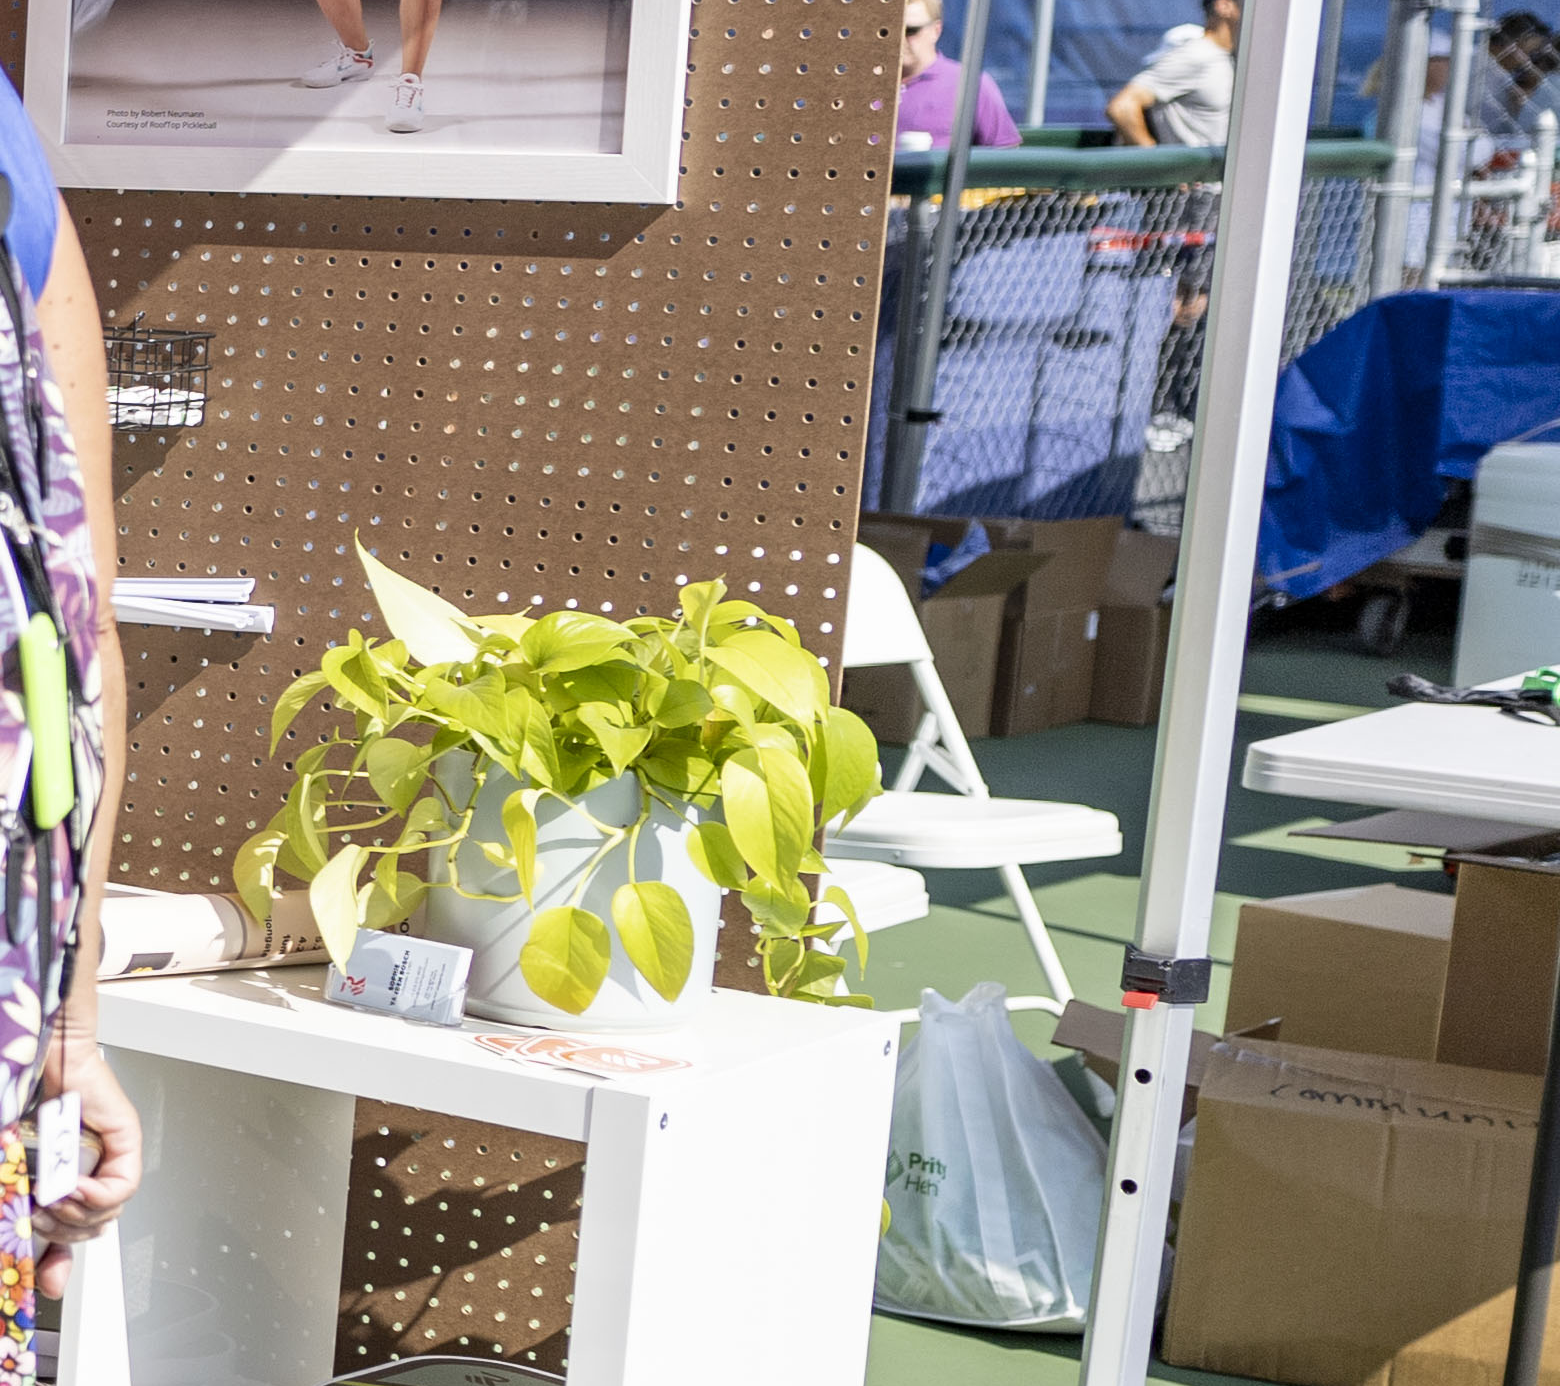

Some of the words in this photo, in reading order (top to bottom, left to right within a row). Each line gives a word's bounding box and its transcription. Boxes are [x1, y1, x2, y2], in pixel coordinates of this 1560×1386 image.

[106, 109, 129, 117] Photo
[131, 109, 140, 119] by
[141, 110, 166, 118] Robert
[106, 120, 139, 130] Courtesy
[140, 121, 149, 129] of
[182, 121, 217, 129] Pickleball
